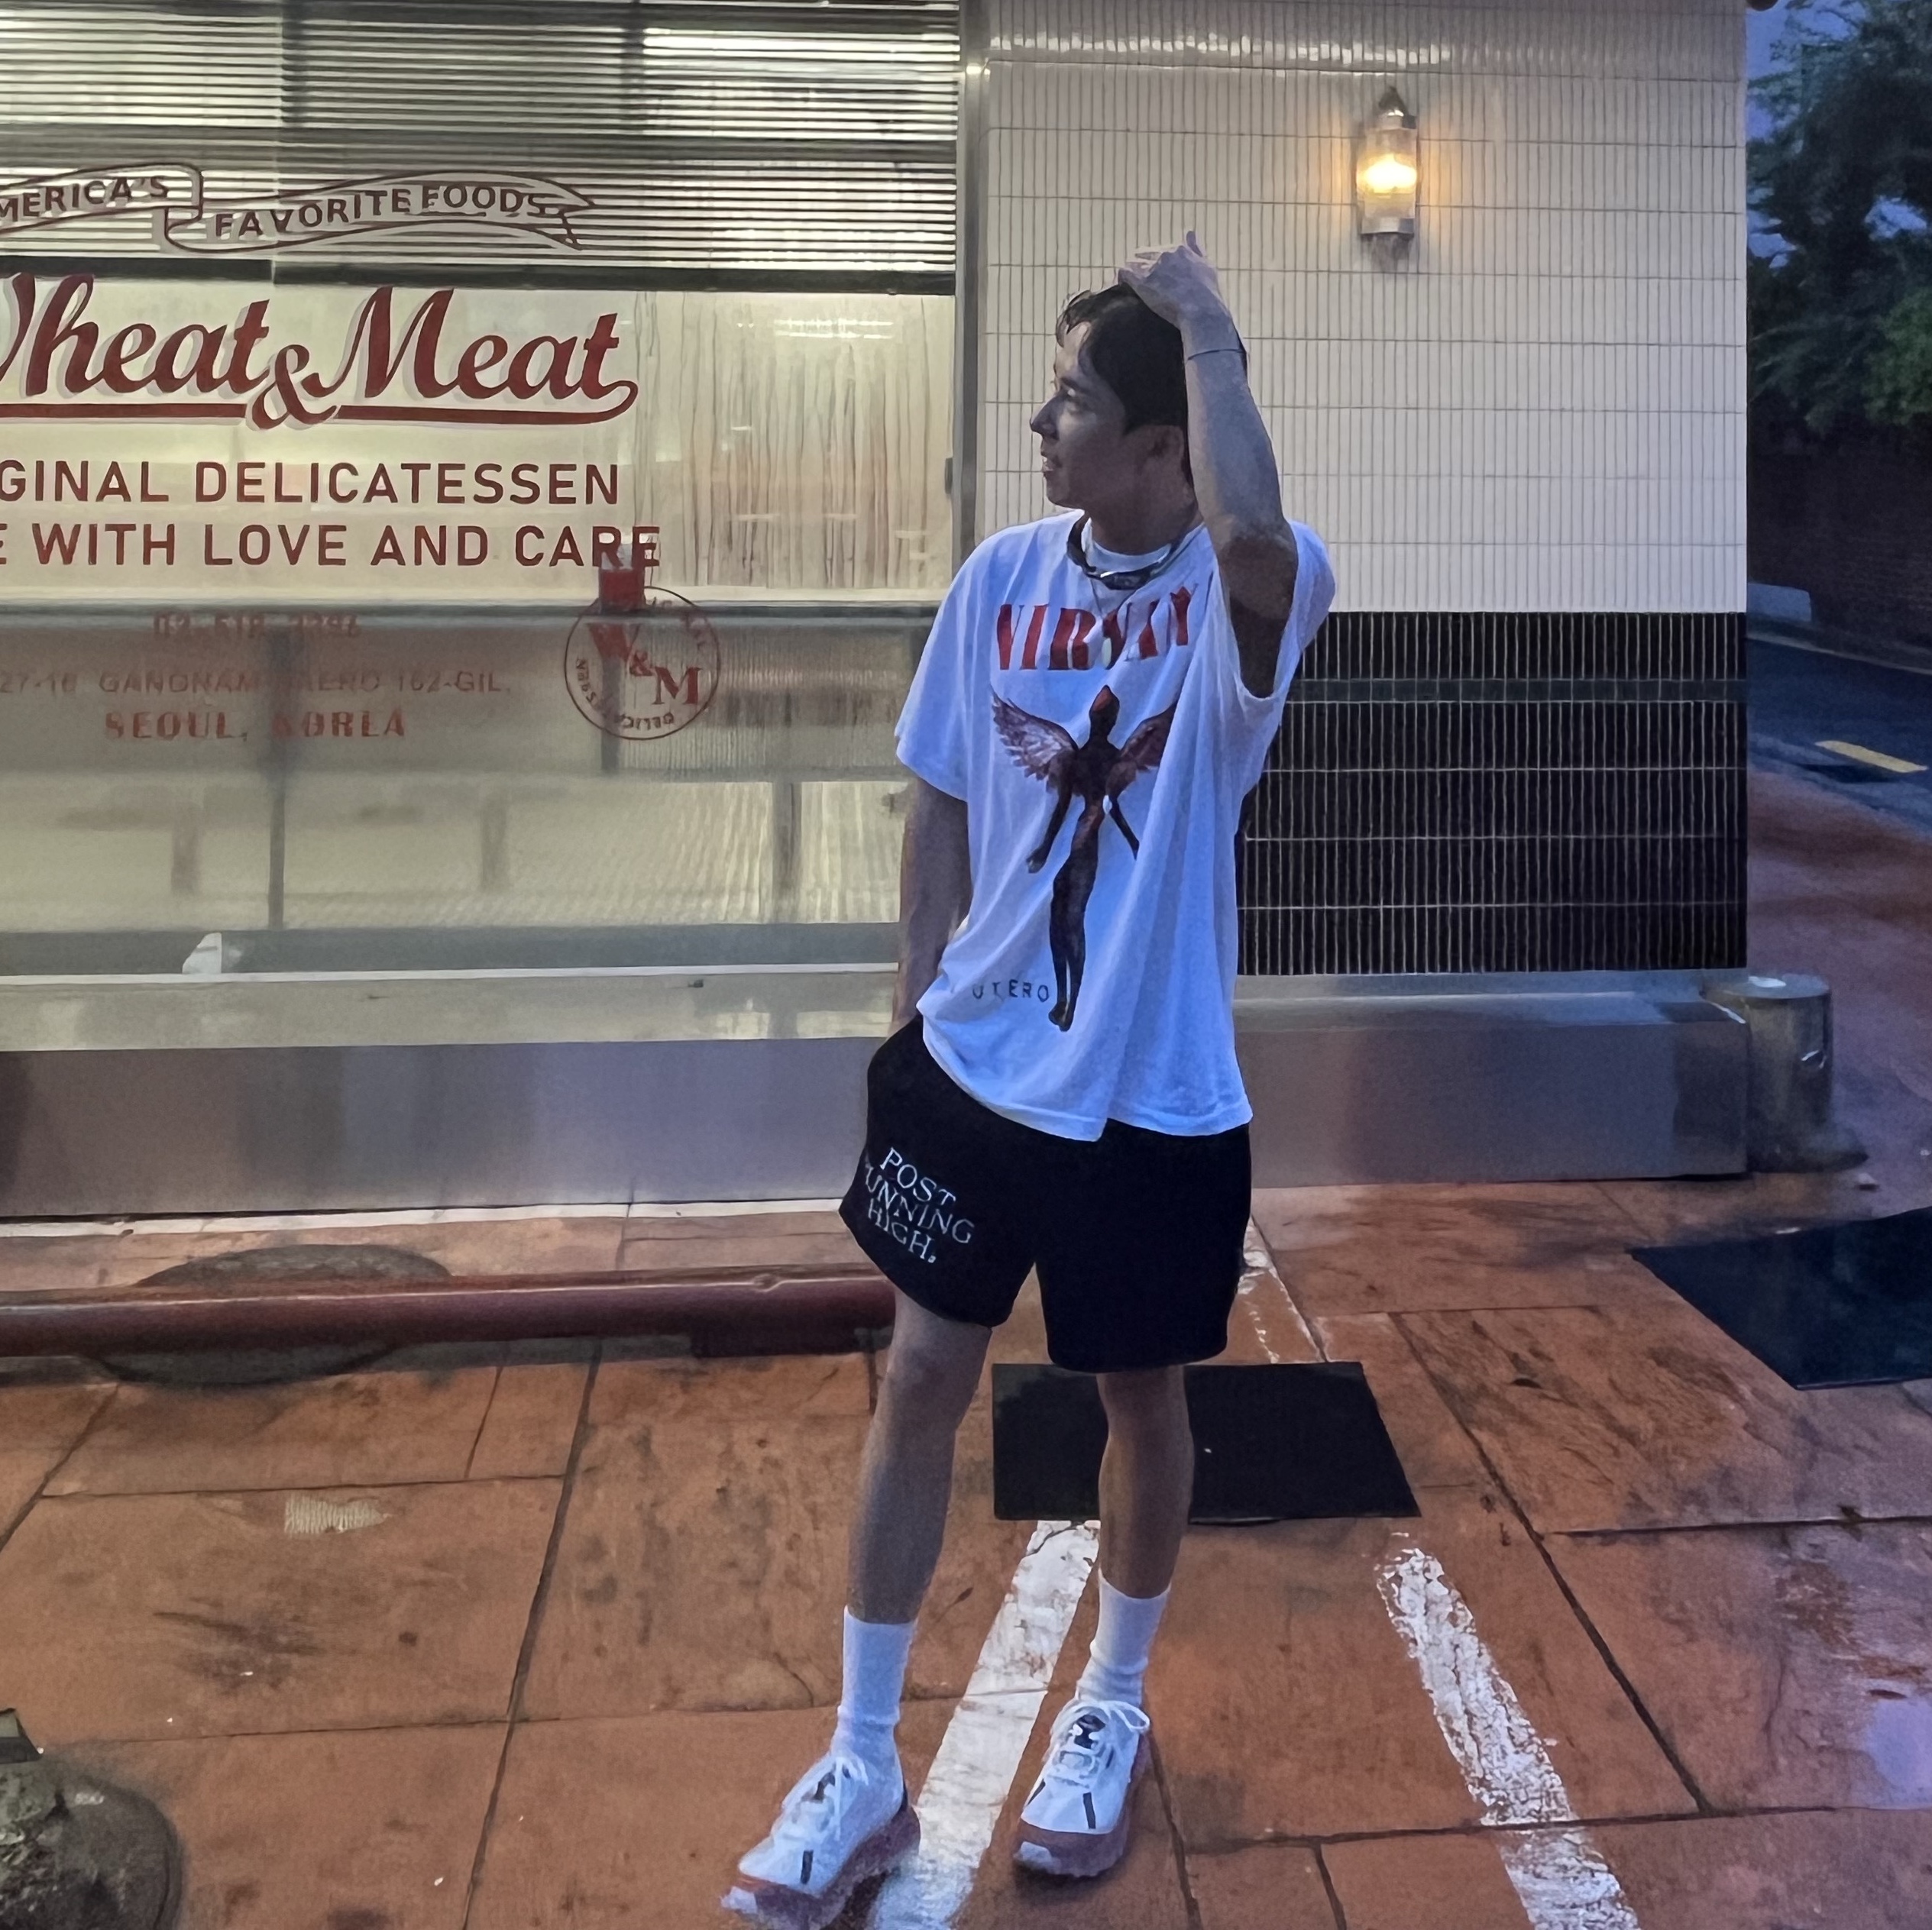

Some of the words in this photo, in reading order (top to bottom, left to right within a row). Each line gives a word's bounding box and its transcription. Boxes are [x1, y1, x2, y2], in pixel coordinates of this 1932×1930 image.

[215, 188, 412, 237] FAVORITE
[422, 184, 546, 215] FOODS
[251, 344, 338, 430] &
[301, 287, 638, 402] Meat
[196, 461, 618, 505] DELICATESSEN
[32, 522, 175, 565] WITH
[205, 523, 347, 566] LOVE
[371, 525, 488, 566] AND
[515, 525, 661, 567] CARE
[864, 1153, 975, 1243] UNNING
[879, 1146, 956, 1206] POST
